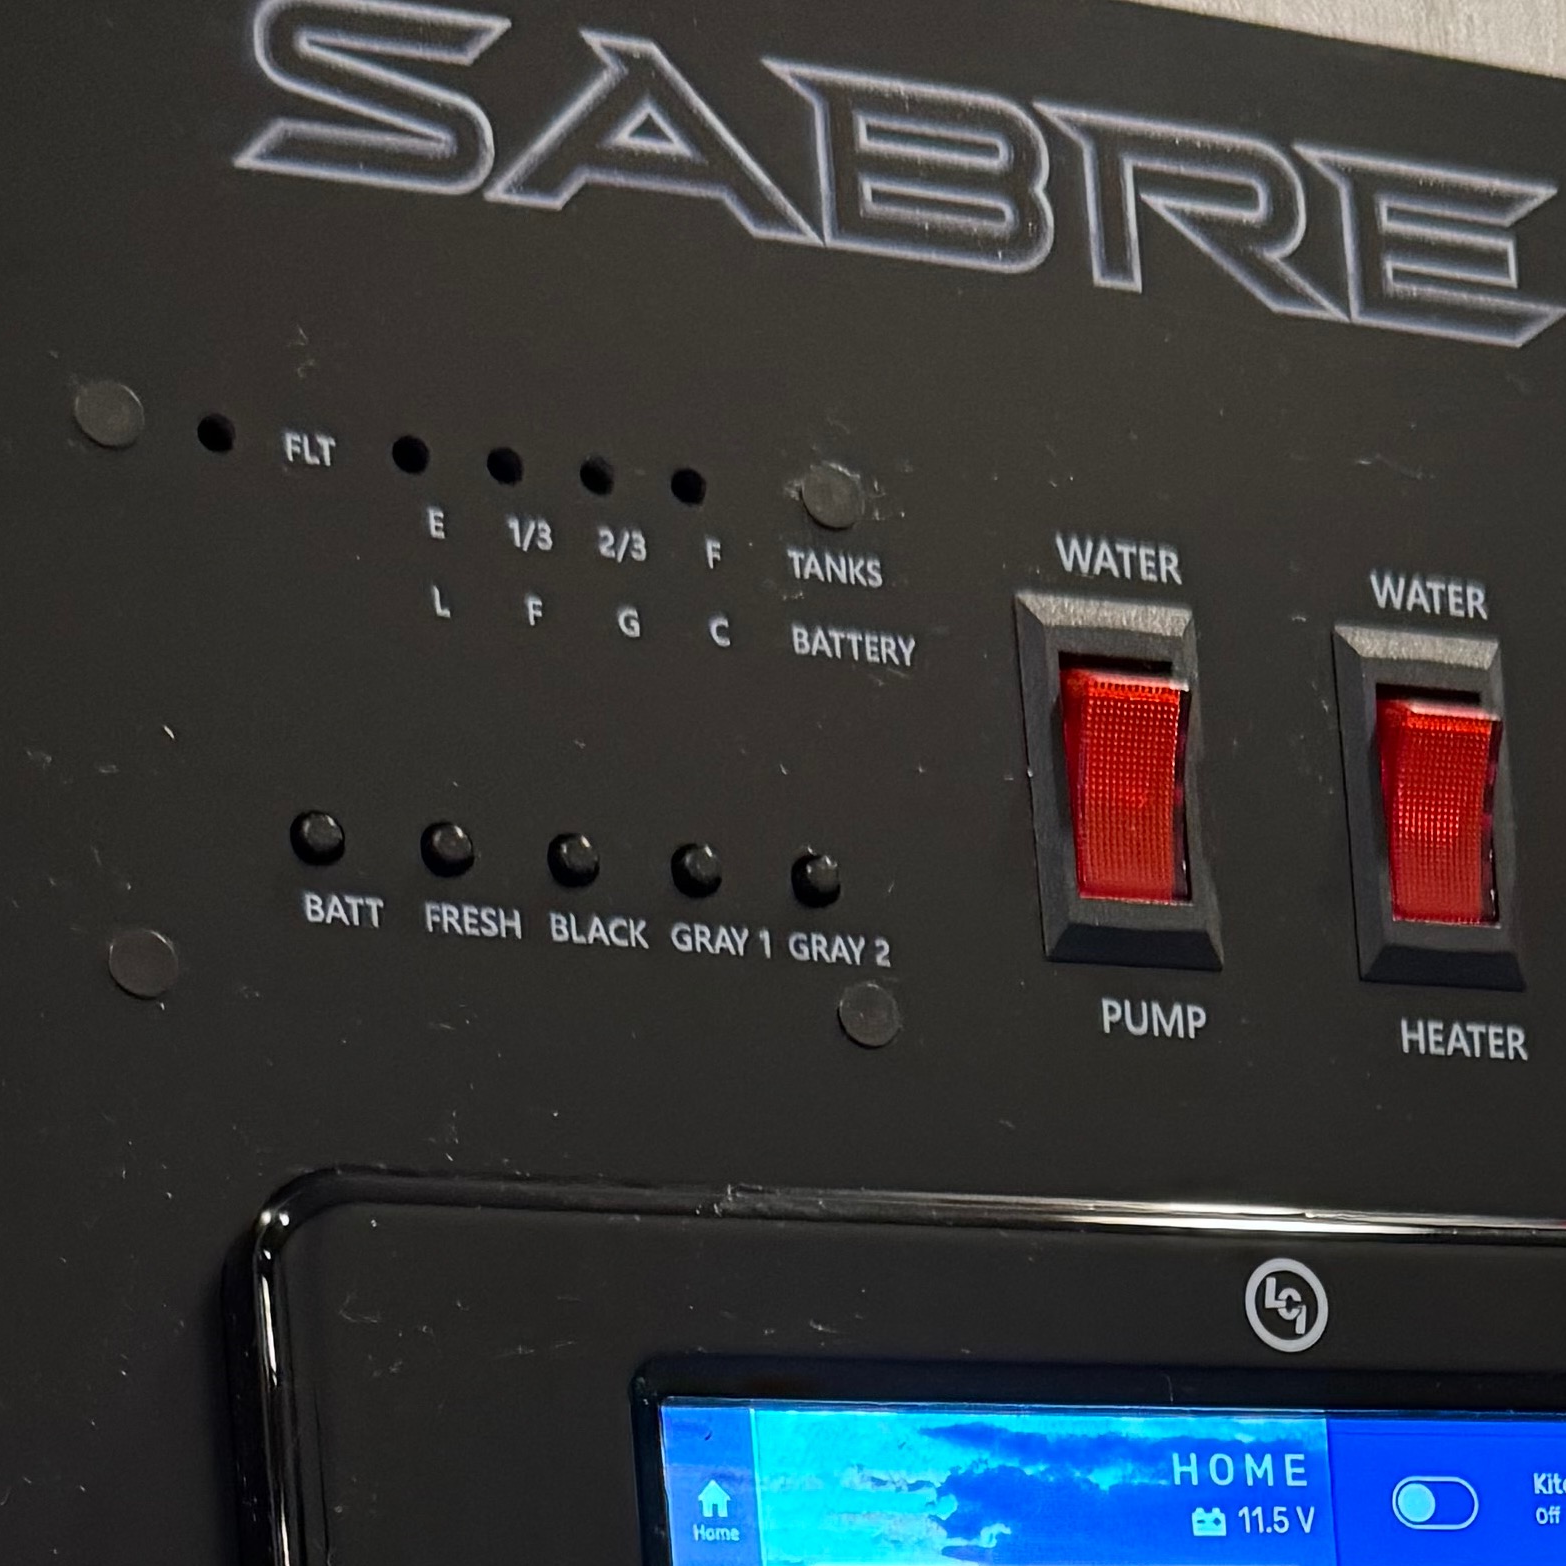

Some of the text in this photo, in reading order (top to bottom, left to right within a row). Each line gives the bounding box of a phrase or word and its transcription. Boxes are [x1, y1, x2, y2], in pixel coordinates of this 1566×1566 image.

[283, 430, 335, 468] FLT
[427, 507, 883, 589] E 1/3 2/3 F TANKS
[1055, 534, 1182, 586] WATER
[1370, 571, 1489, 621] WATER
[432, 587, 917, 668] L F G C BATTERY
[303, 891, 385, 930] BATT
[424, 902, 524, 941] FRESH
[549, 912, 651, 952] BLACK
[670, 923, 771, 959] GRAY 1
[787, 932, 892, 968] GRAY 2
[1100, 1000, 1208, 1040] PUMP
[1399, 1018, 1529, 1062] HEATER
[1171, 1451, 1309, 1488] HOME
[693, 1523, 740, 1543] Home
[1238, 1507, 1316, 1535] 11.5 V
[1535, 1507, 1561, 1525] Off
